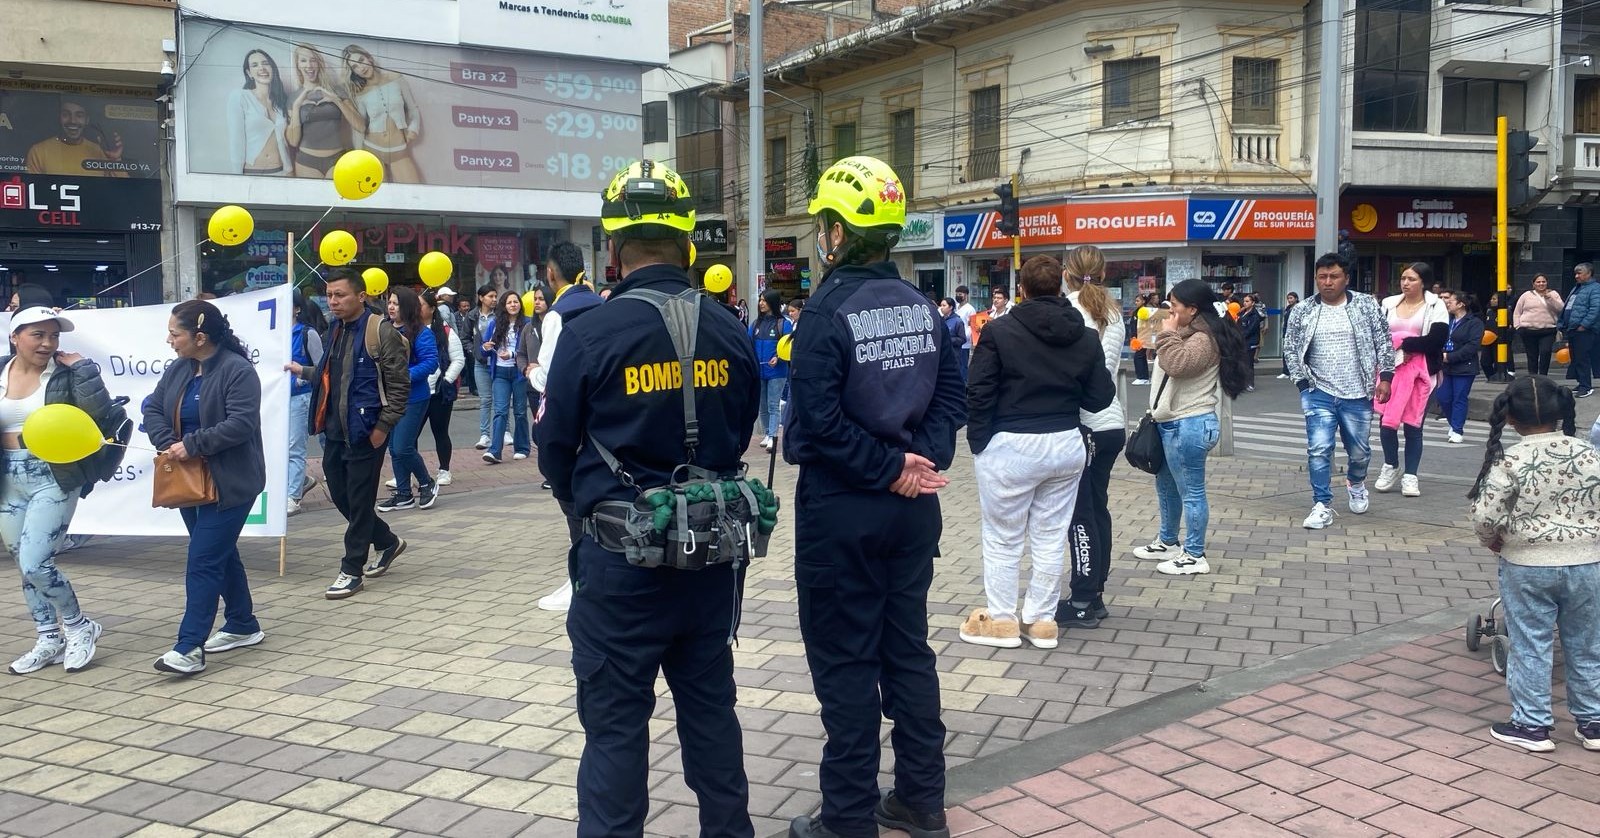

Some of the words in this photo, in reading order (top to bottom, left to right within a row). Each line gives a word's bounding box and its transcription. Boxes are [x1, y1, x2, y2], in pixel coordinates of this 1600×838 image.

[499, 1, 531, 13] Marcas
[533, 6, 539, 14] &
[541, 6, 589, 20] Tendencias
[591, 13, 632, 26] COLOMBIA
[461, 68, 486, 82] Bra
[490, 71, 507, 83] x2
[544, 73, 637, 101] $59.900
[458, 112, 494, 127] Panty
[497, 115, 511, 126] x3
[544, 110, 638, 140] $29.900
[86, 161, 137, 171] SOLICITALO
[460, 155, 495, 170] Panty
[498, 157, 513, 167] x2
[38, 211, 81, 226] CELL
[657, 212, 670, 220] A+
[1075, 212, 1176, 230] DROGUERÍA
[1253, 209, 1314, 221] DROGUERÍA
[1397, 212, 1424, 229] LAS
[1426, 212, 1468, 229] JOTAS
[130, 222, 162, 230] #13-77
[1029, 226, 1063, 237] IPIALES
[847, 303, 934, 342] BOMBEROS
[855, 333, 936, 364] COLOMBIA
[882, 356, 915, 371] IPIALES
[624, 359, 729, 395] BOMBROS
[1076, 524, 1091, 563] adidas
